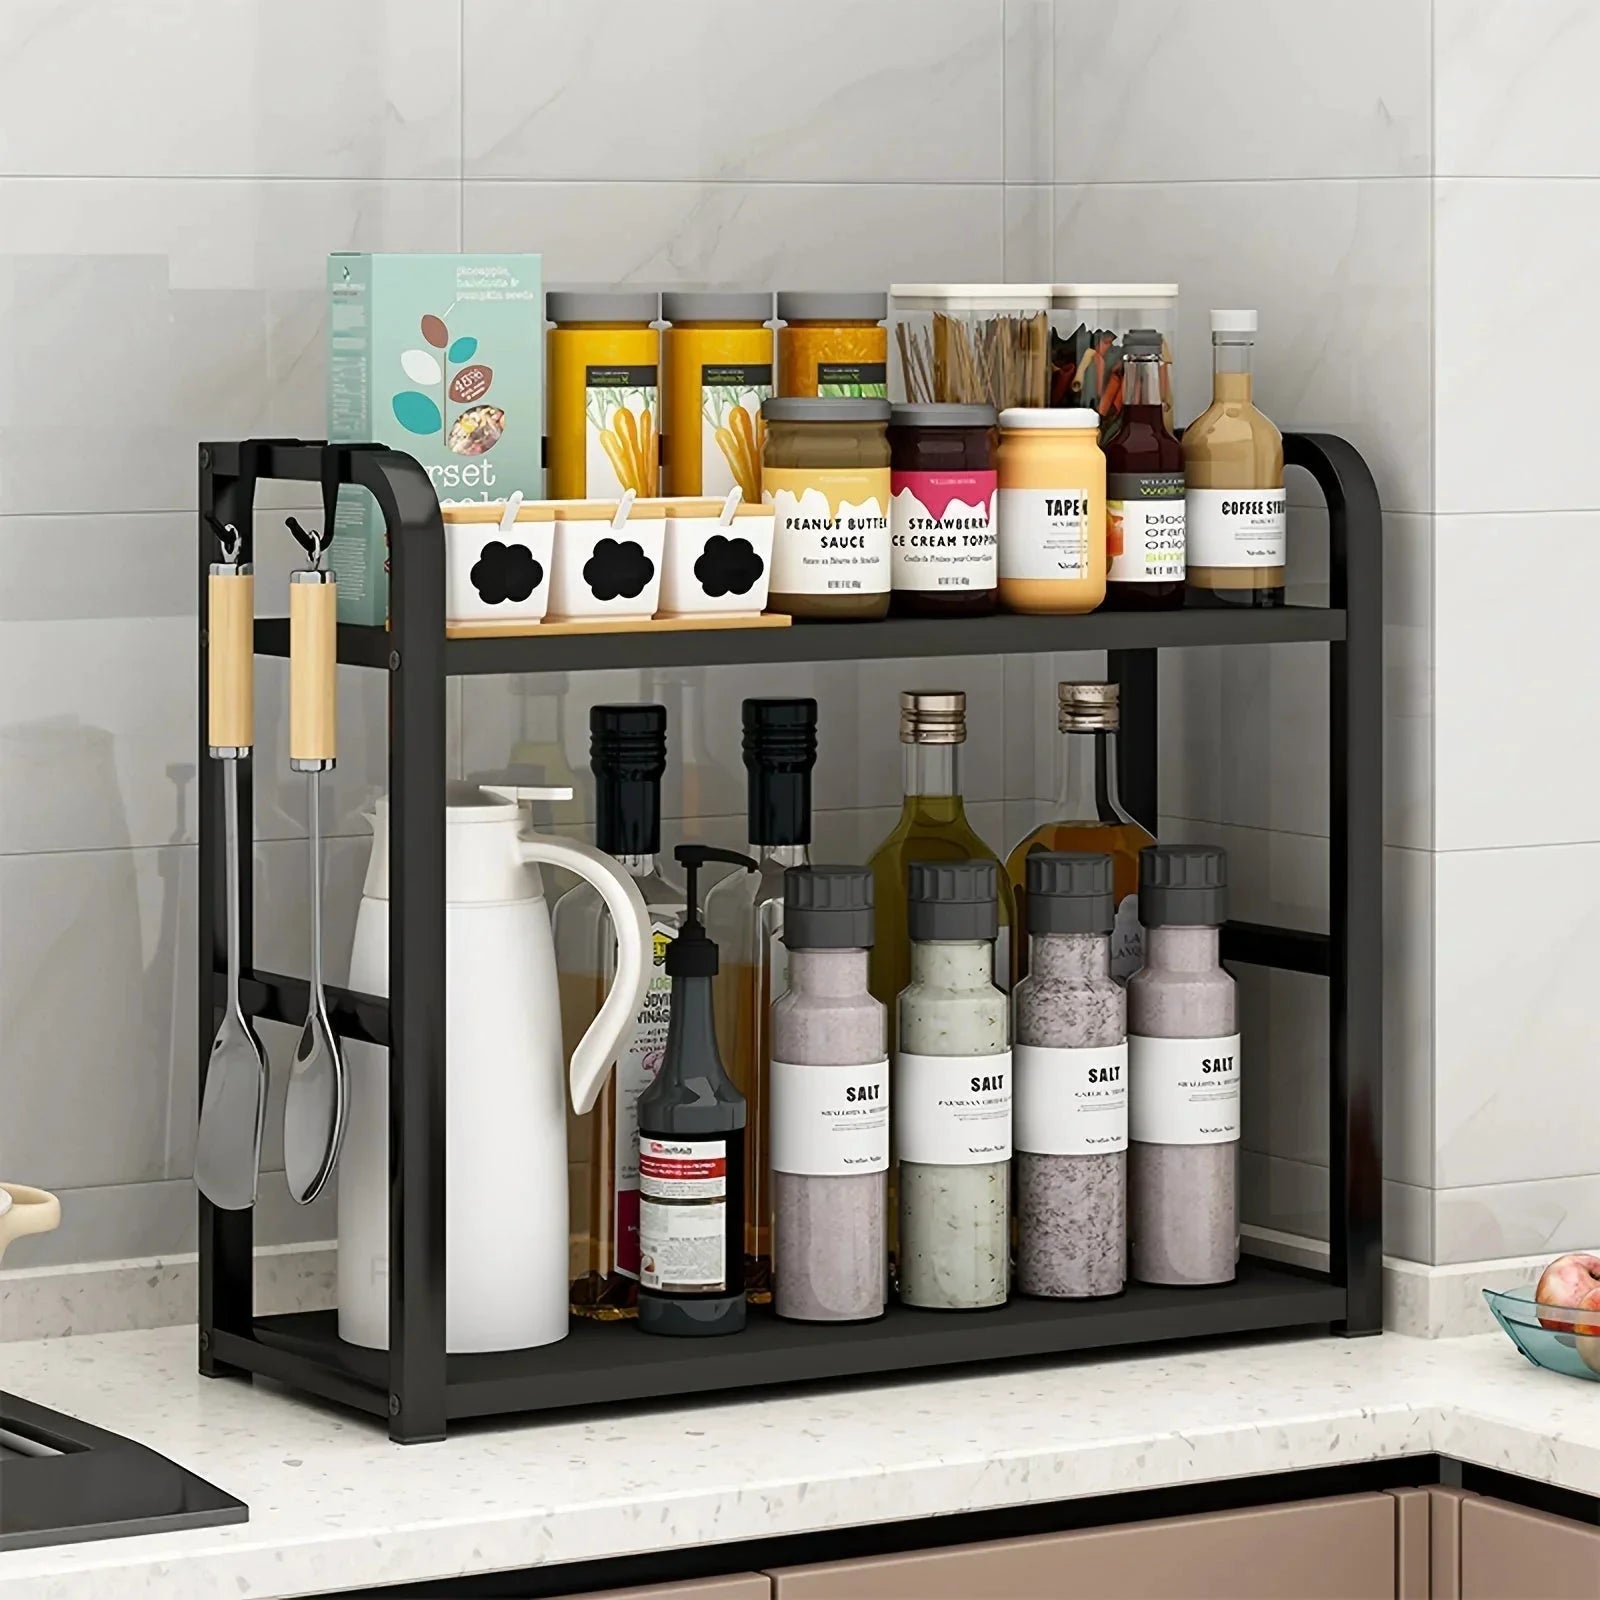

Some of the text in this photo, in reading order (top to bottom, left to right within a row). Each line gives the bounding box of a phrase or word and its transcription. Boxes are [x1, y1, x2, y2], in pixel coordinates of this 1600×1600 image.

[424, 458, 496, 487] rset
[1222, 501, 1264, 515] COFFEE
[786, 517, 842, 531] PEANUT
[820, 535, 865, 549] SAUCE
[891, 535, 906, 547] CE
[910, 535, 957, 547] CREAM
[1202, 1056, 1234, 1074] SALT
[970, 1074, 1004, 1092] SALT
[1088, 1066, 1121, 1083] SALT
[846, 1084, 880, 1102] SALT
